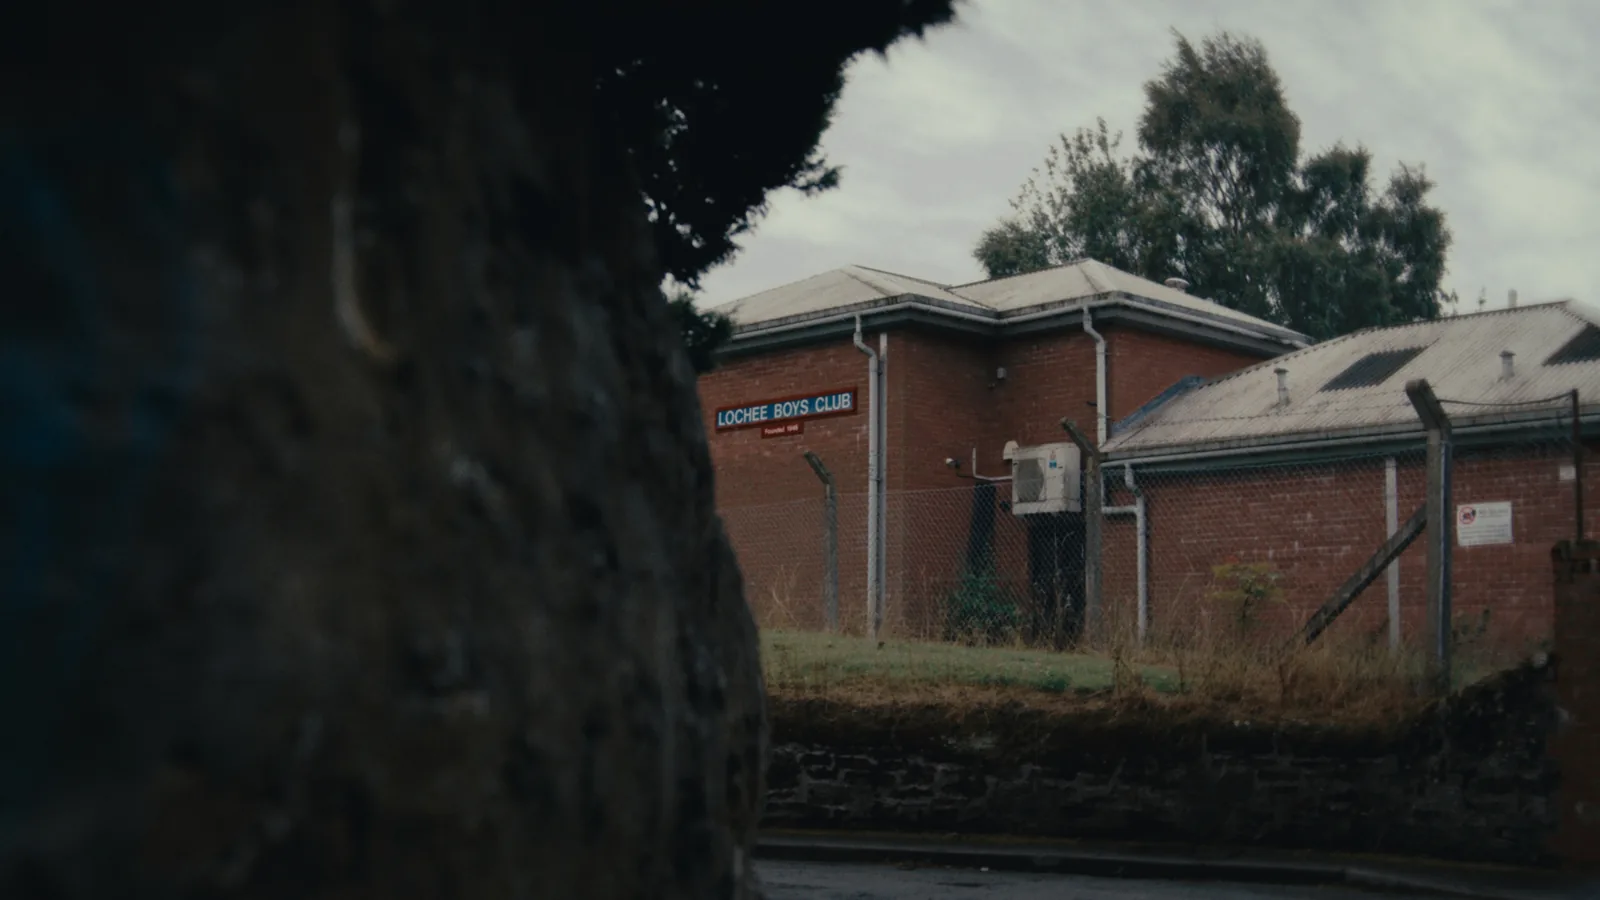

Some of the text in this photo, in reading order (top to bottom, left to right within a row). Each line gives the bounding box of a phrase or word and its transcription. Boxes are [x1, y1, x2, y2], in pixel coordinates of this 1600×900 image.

[718, 393, 851, 426] LOCHEE BOYS CLUB
